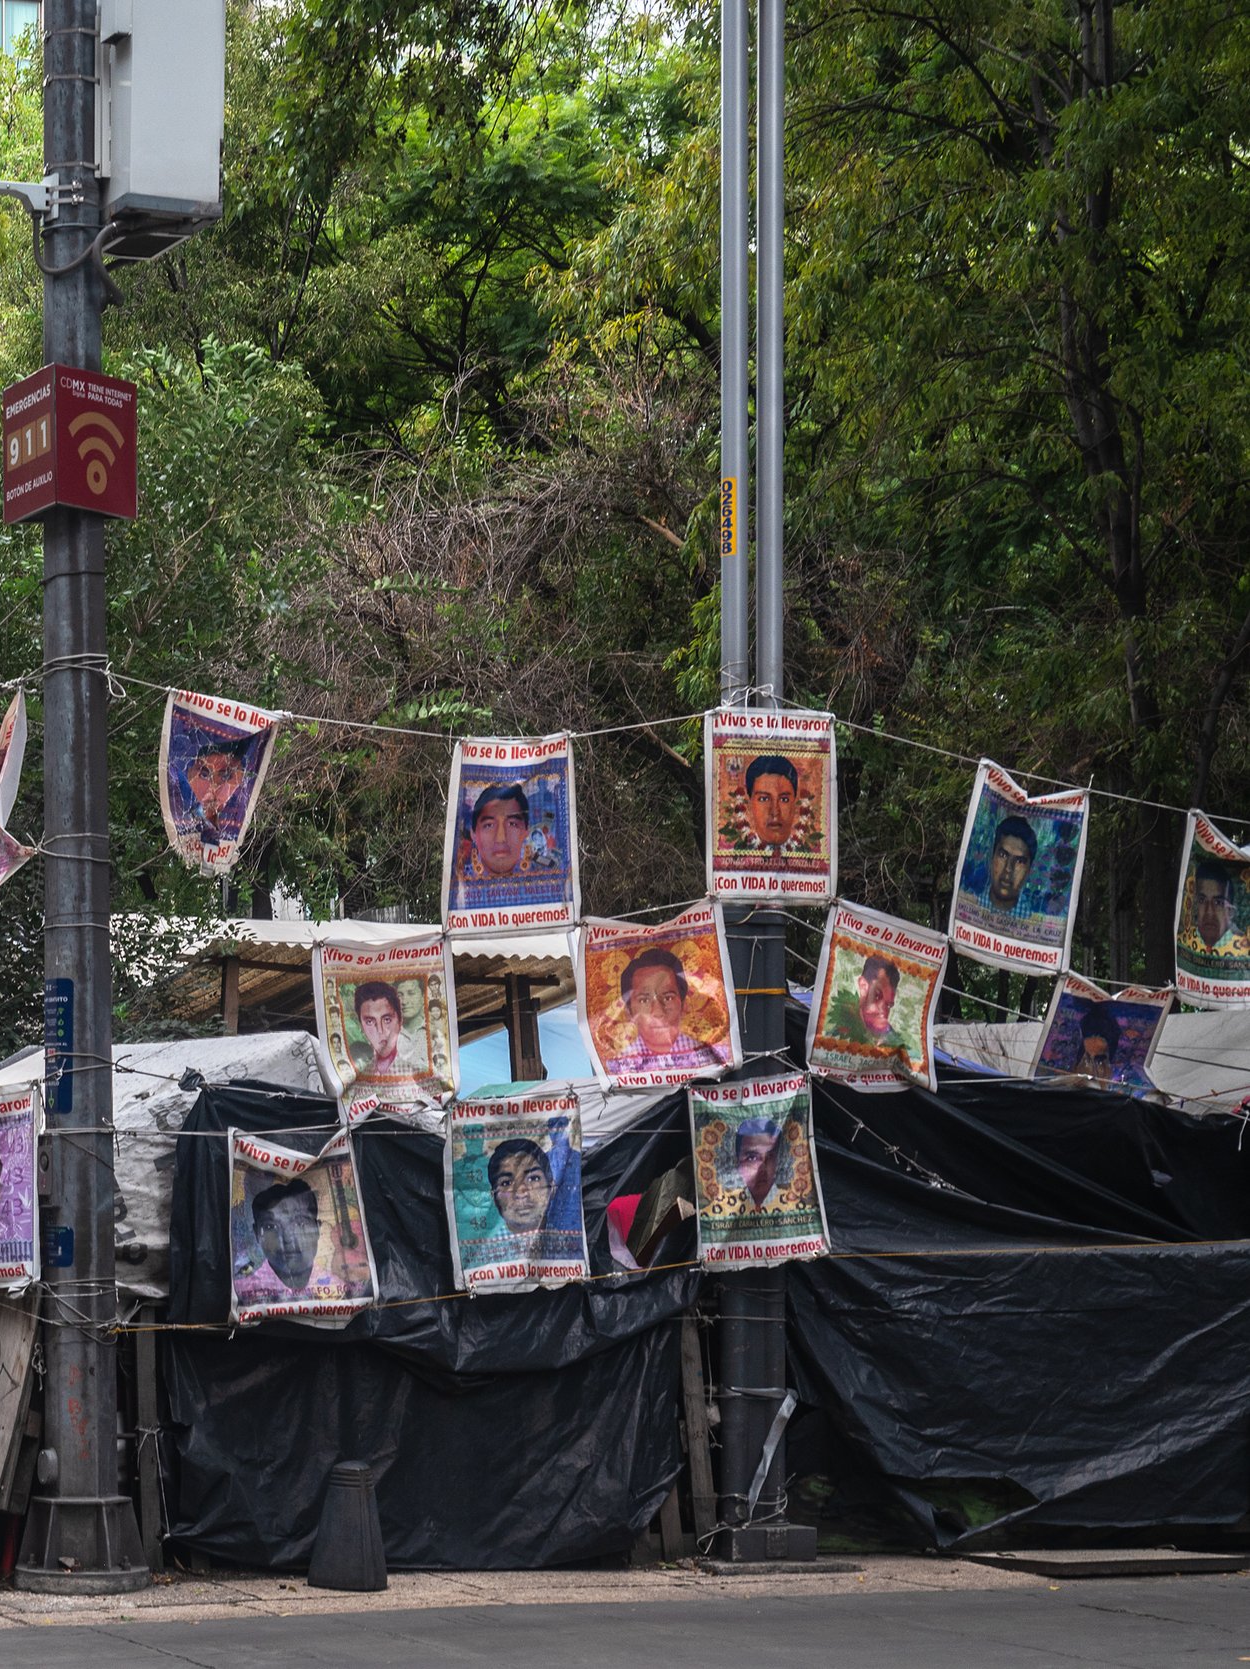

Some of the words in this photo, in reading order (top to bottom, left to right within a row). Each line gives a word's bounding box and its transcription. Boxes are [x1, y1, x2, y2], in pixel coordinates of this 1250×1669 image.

[60, 376, 85, 392] CDMX
[88, 383, 104, 395] TIENE
[105, 388, 132, 402] INTERNET
[6, 384, 51, 419] EMERGENCIAS
[88, 392, 104, 403] PARA
[6, 485, 25, 501] BOTÓN
[25, 481, 32, 493] DE
[32, 471, 53, 488] AUXILIO
[722, 481, 733, 554] 026498
[217, 703, 232, 717] se
[234, 706, 246, 722] lo
[714, 713, 747, 728] ¡Vivo
[750, 716, 763, 728] se
[767, 715, 778, 728] lo
[480, 746, 492, 758] se
[495, 745, 507, 759] lo
[511, 738, 567, 759] llevaron!
[1011, 791, 1026, 803] se
[1211, 841, 1226, 854] se
[714, 876, 738, 892] ¡Con
[741, 876, 766, 890] VIDA
[769, 877, 779, 891] lo
[780, 879, 826, 896] queremos!
[448, 915, 469, 930] ¡Con
[470, 912, 496, 927] VIDA
[498, 911, 509, 926] lo
[511, 907, 570, 927] queremos!
[587, 927, 617, 943] ¡Vivo
[836, 910, 863, 931] ¡Vivo
[864, 924, 880, 937] se
[881, 927, 893, 942] lo
[894, 931, 945, 960] llevaron!
[323, 947, 353, 964] ¡Vivo
[357, 955, 373, 966] se
[375, 952, 385, 962] lo
[389, 943, 443, 961] llevaron!
[956, 926, 971, 940] ¡Con
[973, 931, 991, 950] VIDA
[993, 938, 1002, 952] lo
[1004, 943, 1058, 965] queremos!
[1202, 981, 1210, 995] lo
[617, 1075, 647, 1088] ¡Vivo
[650, 1073, 663, 1085] lo
[723, 1087, 737, 1100] se
[753, 1075, 806, 1097] llevaron!
[349, 1099, 378, 1121] ¡Vivo
[452, 1103, 485, 1121] ¡Vivo
[490, 1103, 503, 1115] se
[507, 1101, 519, 1114] lo
[522, 1097, 579, 1114] llevaron!
[234, 1139, 271, 1165] ¡Vivo
[273, 1154, 290, 1170] se
[706, 1246, 726, 1262] ¡Con
[728, 1244, 750, 1260] VIDA
[752, 1244, 763, 1259] lo
[765, 1238, 825, 1261] queremos!
[498, 1264, 526, 1279] VIDA
[299, 1305, 309, 1315] lo
